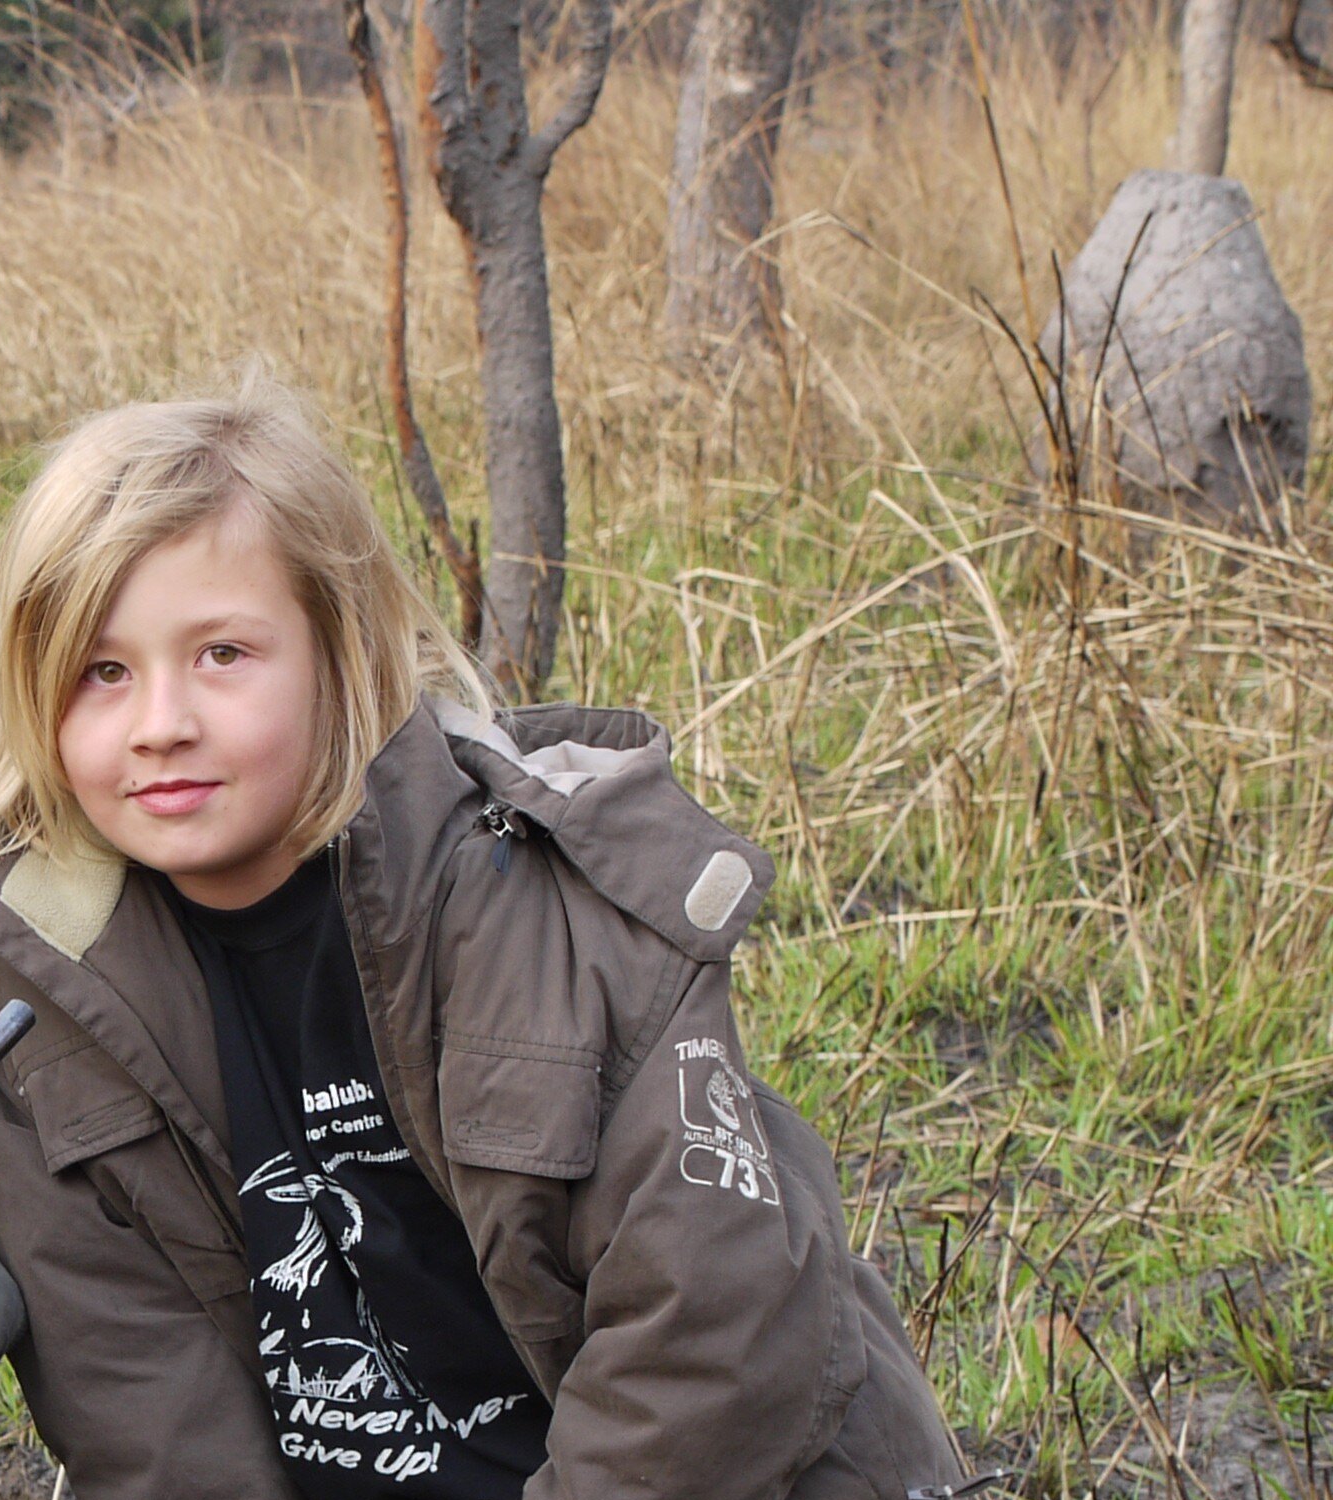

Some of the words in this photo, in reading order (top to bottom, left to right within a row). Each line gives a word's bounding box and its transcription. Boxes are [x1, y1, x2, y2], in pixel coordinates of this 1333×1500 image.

[330, 1114, 384, 1134] Centre
[715, 1148, 760, 1200] 73
[288, 1398, 424, 1435] Never,
[279, 1432, 362, 1469] Give
[373, 1442, 442, 1483] Up!
